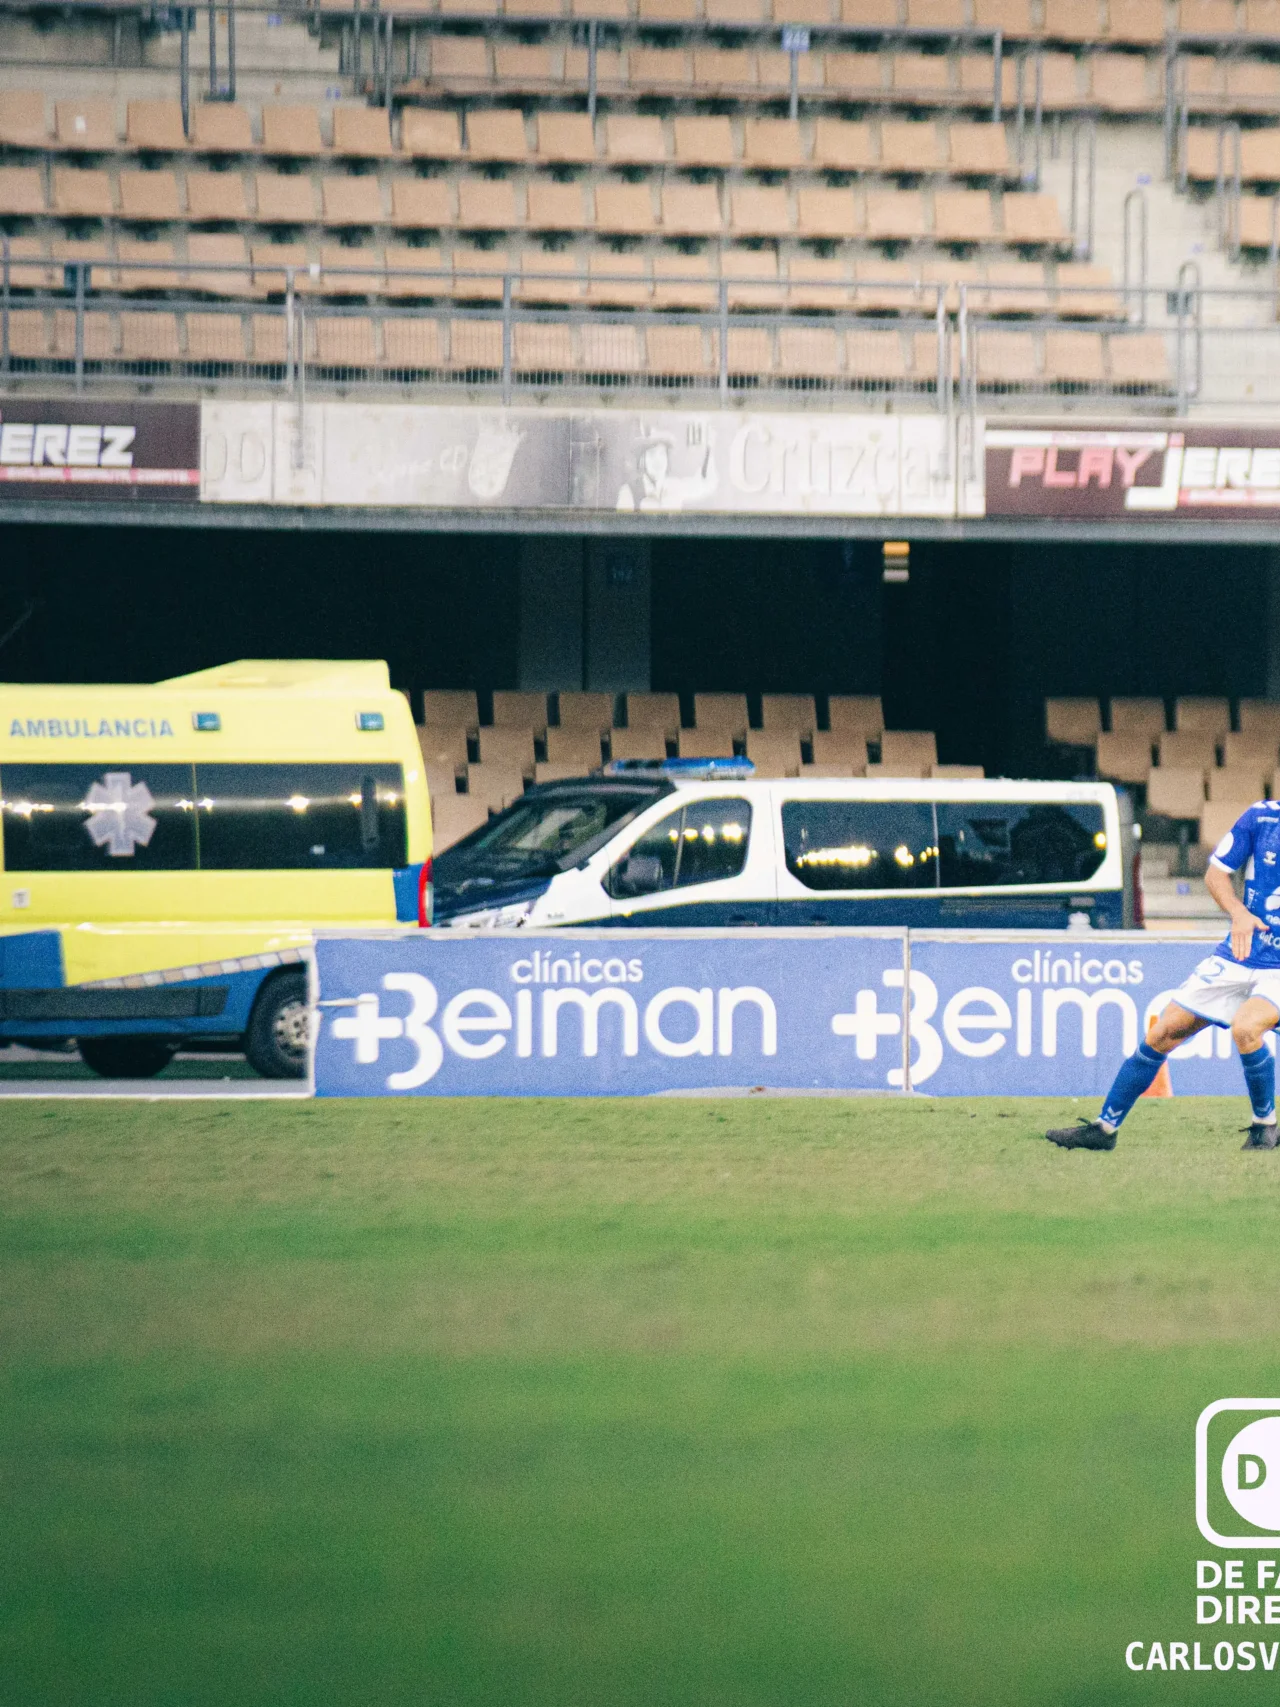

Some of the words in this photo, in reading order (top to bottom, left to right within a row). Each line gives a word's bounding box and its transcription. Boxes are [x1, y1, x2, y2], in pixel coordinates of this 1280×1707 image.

[1009, 445, 1152, 489] PLAY
[10, 718, 174, 738] AMBULANCIA
[511, 950, 643, 984] clínicas
[1011, 949, 1144, 984] clínicas
